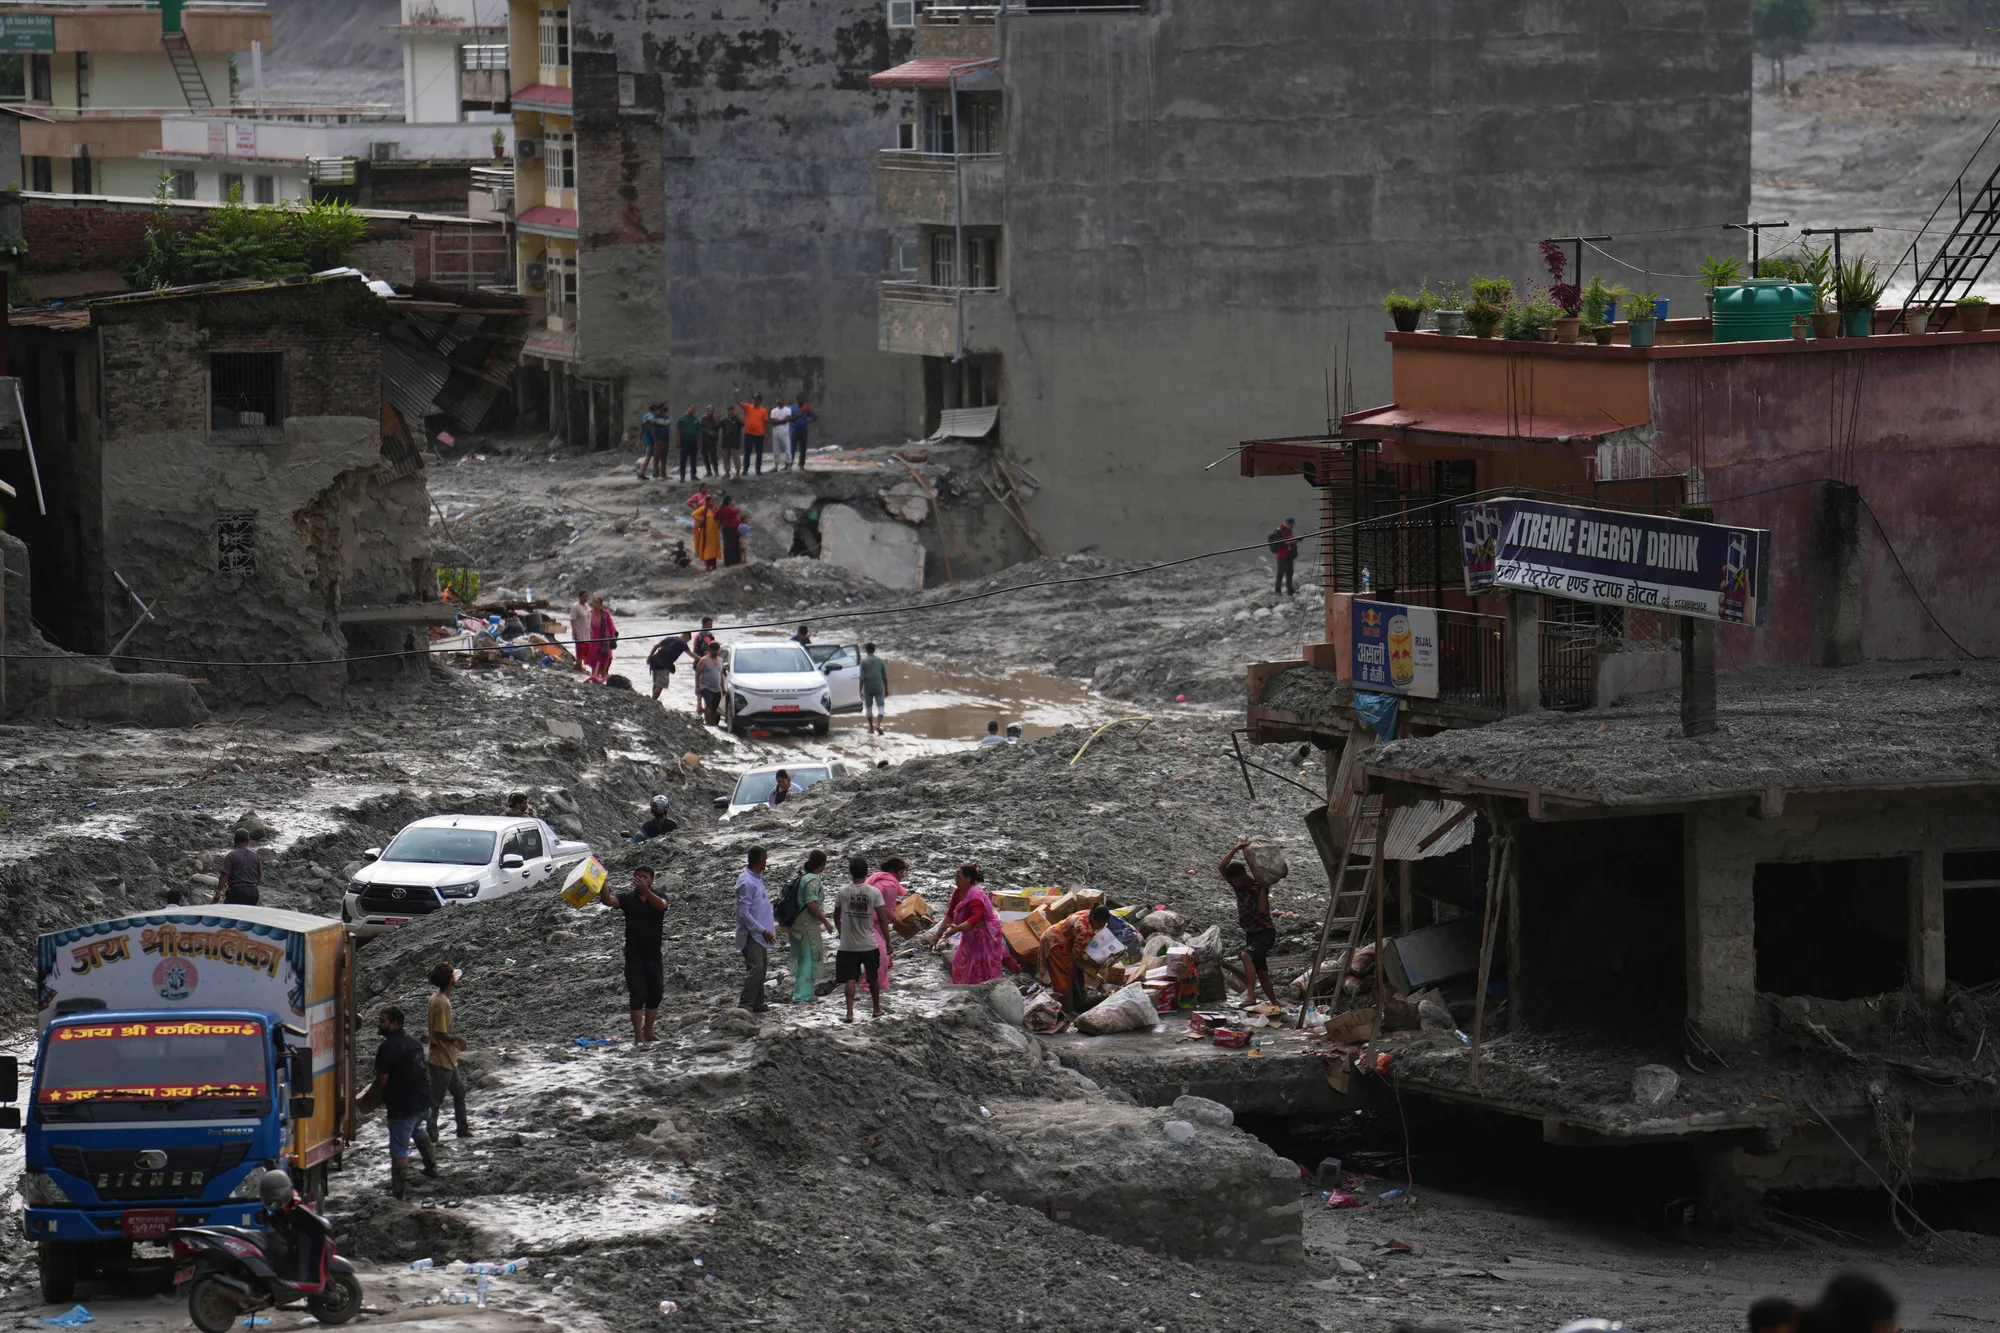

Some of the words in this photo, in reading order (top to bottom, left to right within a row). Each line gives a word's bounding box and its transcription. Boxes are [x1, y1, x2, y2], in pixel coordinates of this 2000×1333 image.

[1577, 520, 1642, 564] ENERGY
[1646, 530, 1700, 573] DRINK
[1567, 575, 1590, 594] एण्ड
[1592, 579, 1624, 599] स्टाफ
[1626, 579, 1659, 606] होटल
[1414, 636, 1432, 648] RIJAL
[70, 934, 130, 976] जय
[73, 1027, 115, 1039] जय
[121, 1024, 148, 1037] श्री
[154, 1022, 242, 1036] कालिका
[160, 1087, 194, 1098] जय
[97, 1172, 204, 1188] EICHER
